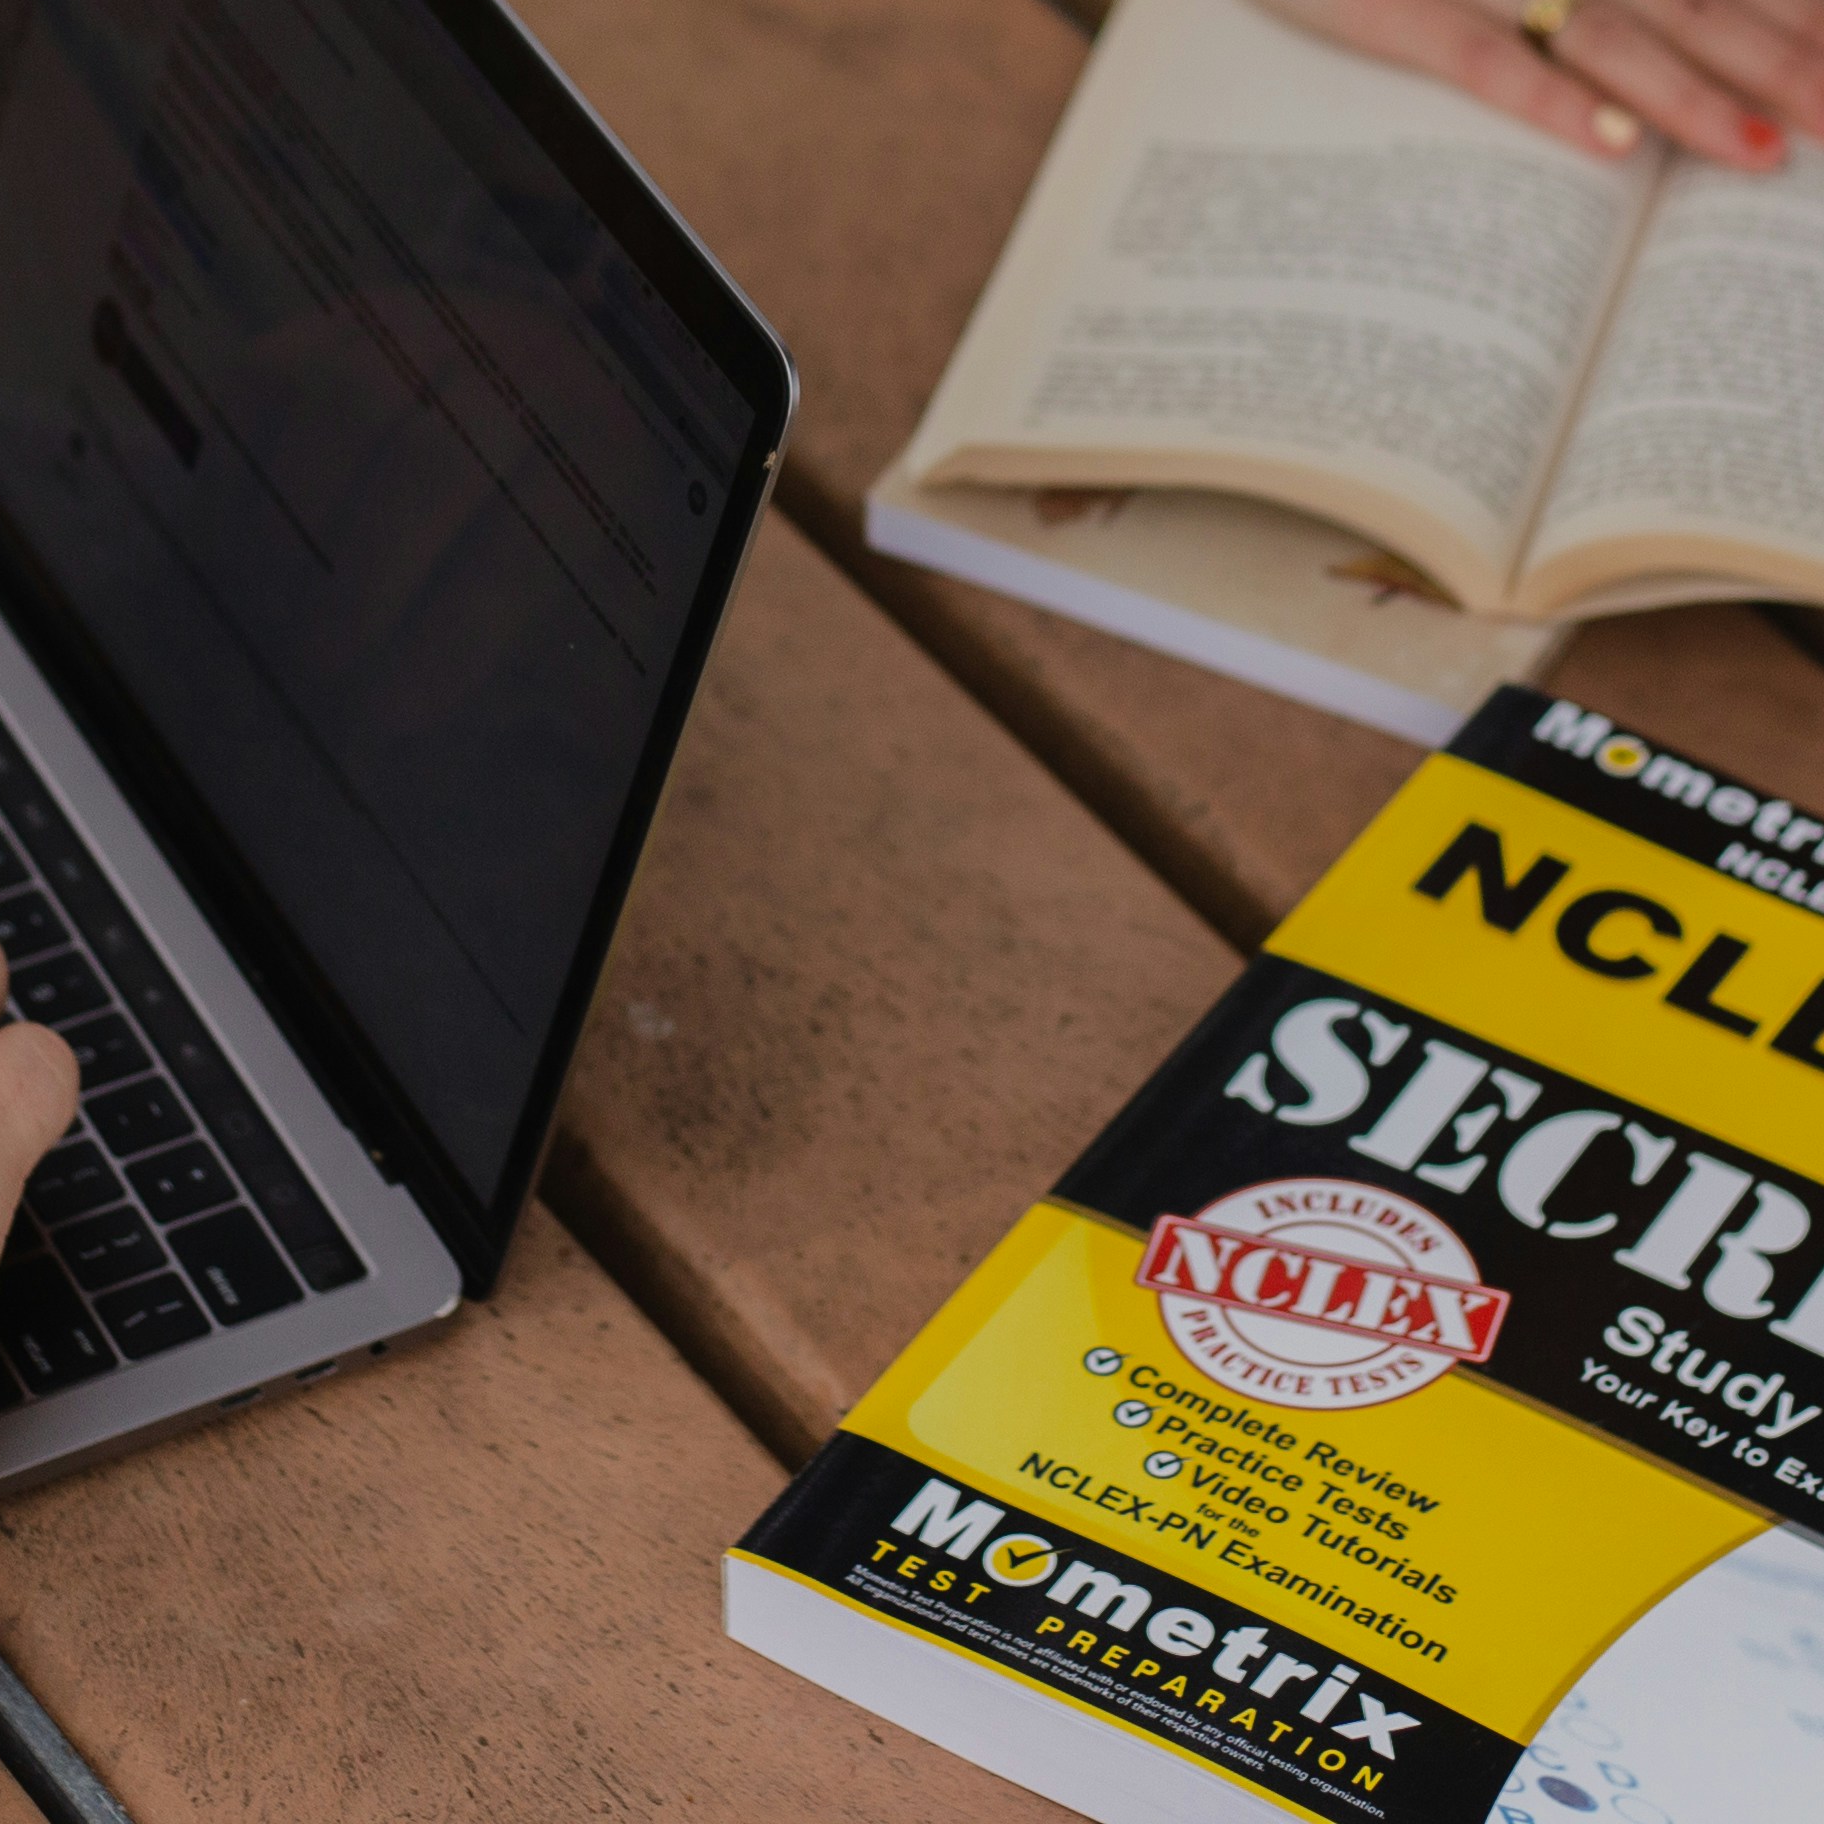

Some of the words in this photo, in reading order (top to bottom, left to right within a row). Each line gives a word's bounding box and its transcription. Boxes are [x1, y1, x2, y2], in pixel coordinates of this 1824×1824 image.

[1156, 1226, 1490, 1351] NCLEX
[1257, 1194, 1442, 1253] INCLUDES
[1182, 1310, 1307, 1394] PRACTICE
[1329, 1359, 1421, 1396] TESTS
[1580, 1357, 1658, 1409] Your
[1659, 1399, 1730, 1448] Key
[1732, 1437, 1770, 1467] to
[1603, 1306, 1822, 1439] Study
[1129, 1365, 1297, 1451] Complete
[1304, 1441, 1440, 1514] Review
[1156, 1415, 1303, 1492] Practice
[1317, 1481, 1409, 1541] Tests
[1019, 1452, 1217, 1550] NCLEX-PN
[1219, 1539, 1448, 1663] Examination
[1192, 1465, 1289, 1524] Video
[1303, 1513, 1457, 1604] Tutorials
[1196, 1503, 1225, 1521] for
[1228, 1518, 1260, 1537] the
[871, 1539, 992, 1604] TEST
[1035, 1616, 1384, 1792] PREPARATION
[890, 1478, 1422, 1761] Mometrix
[910, 1590, 936, 1607] Test
[934, 1601, 1002, 1635] Preparation
[1033, 1647, 1089, 1674] affiliated
[1087, 1670, 1115, 1687] with
[1129, 1690, 1187, 1719] endorsed
[1225, 1735, 1269, 1759] official
[1267, 1754, 1309, 1782] testing
[1309, 1777, 1385, 1819] organization.
[966, 1628, 992, 1643] test
[990, 1639, 1029, 1660] names
[1050, 1665, 1116, 1700] trademarks
[1130, 1702, 1161, 1719] their
[1159, 1716, 1221, 1749] respective
[1220, 1745, 1265, 1772] owners.
